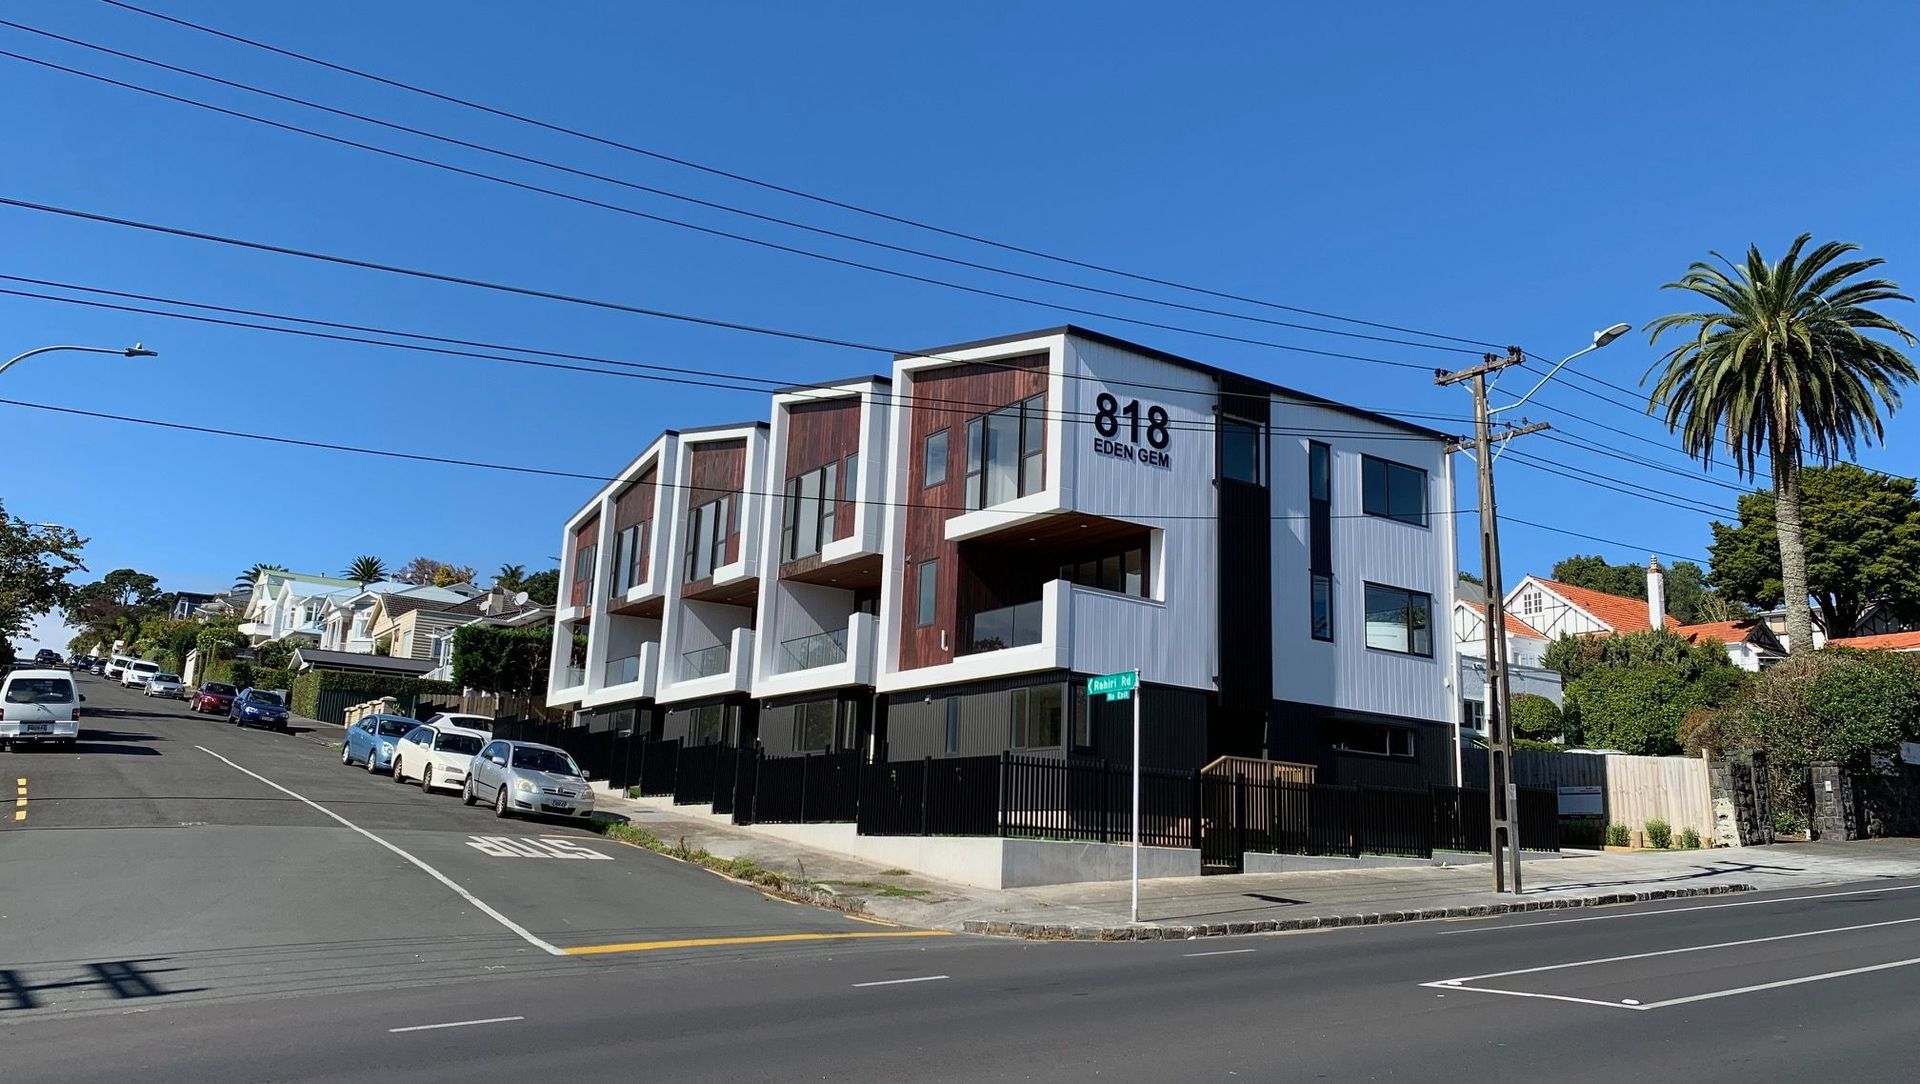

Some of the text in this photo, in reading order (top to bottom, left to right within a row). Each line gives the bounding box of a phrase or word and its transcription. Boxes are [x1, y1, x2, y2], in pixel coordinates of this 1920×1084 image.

[1095, 393, 1169, 449] 818
[1094, 437, 1169, 468] EDEN GEM
[1121, 675, 1131, 688] Rd
[465, 835, 615, 860] STOP
